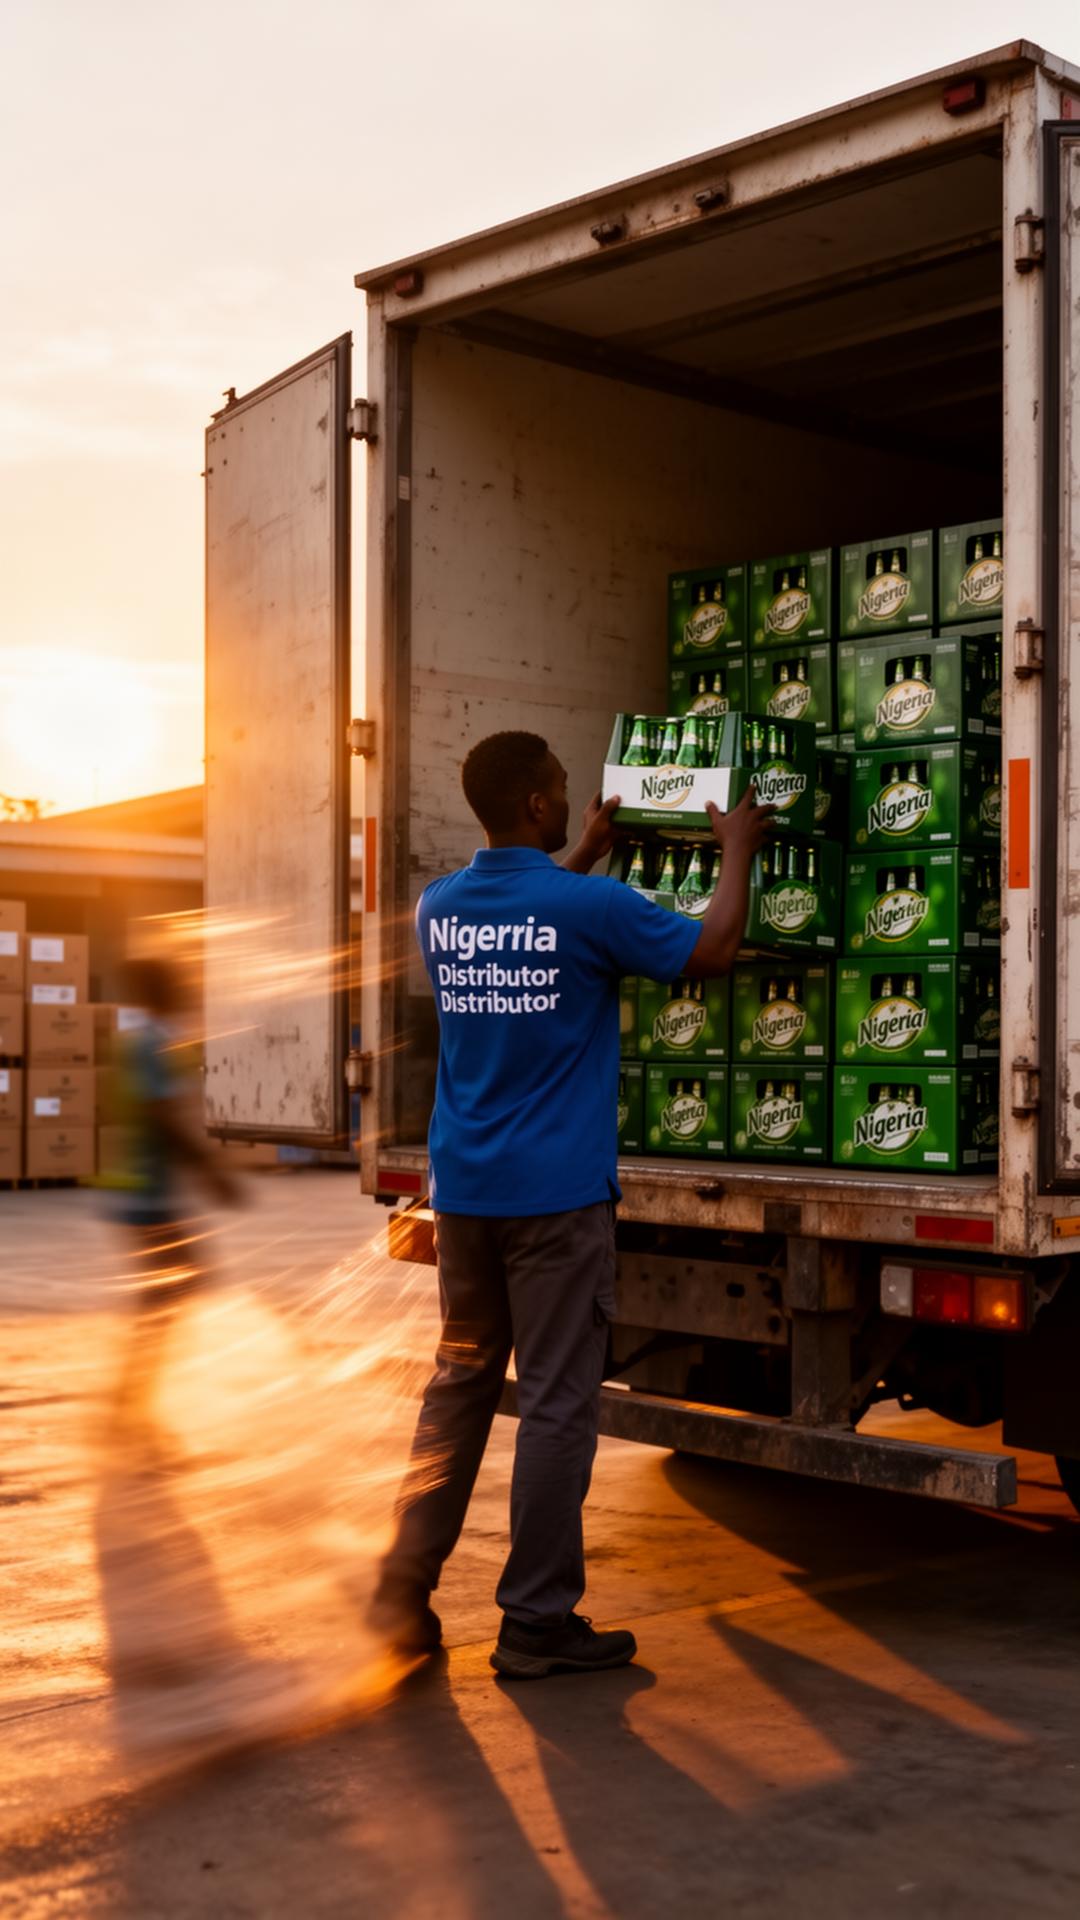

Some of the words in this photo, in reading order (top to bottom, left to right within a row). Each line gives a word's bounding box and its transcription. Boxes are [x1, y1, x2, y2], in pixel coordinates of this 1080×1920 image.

[877, 688, 934, 725] Nigeria
[869, 790, 931, 833] Nigeria
[761, 893, 816, 923] Nigeria
[429, 915, 558, 961] Nigerria
[438, 962, 560, 987] Distributor
[440, 990, 561, 1014] Distributor
[856, 1106, 925, 1145] Nigeria
